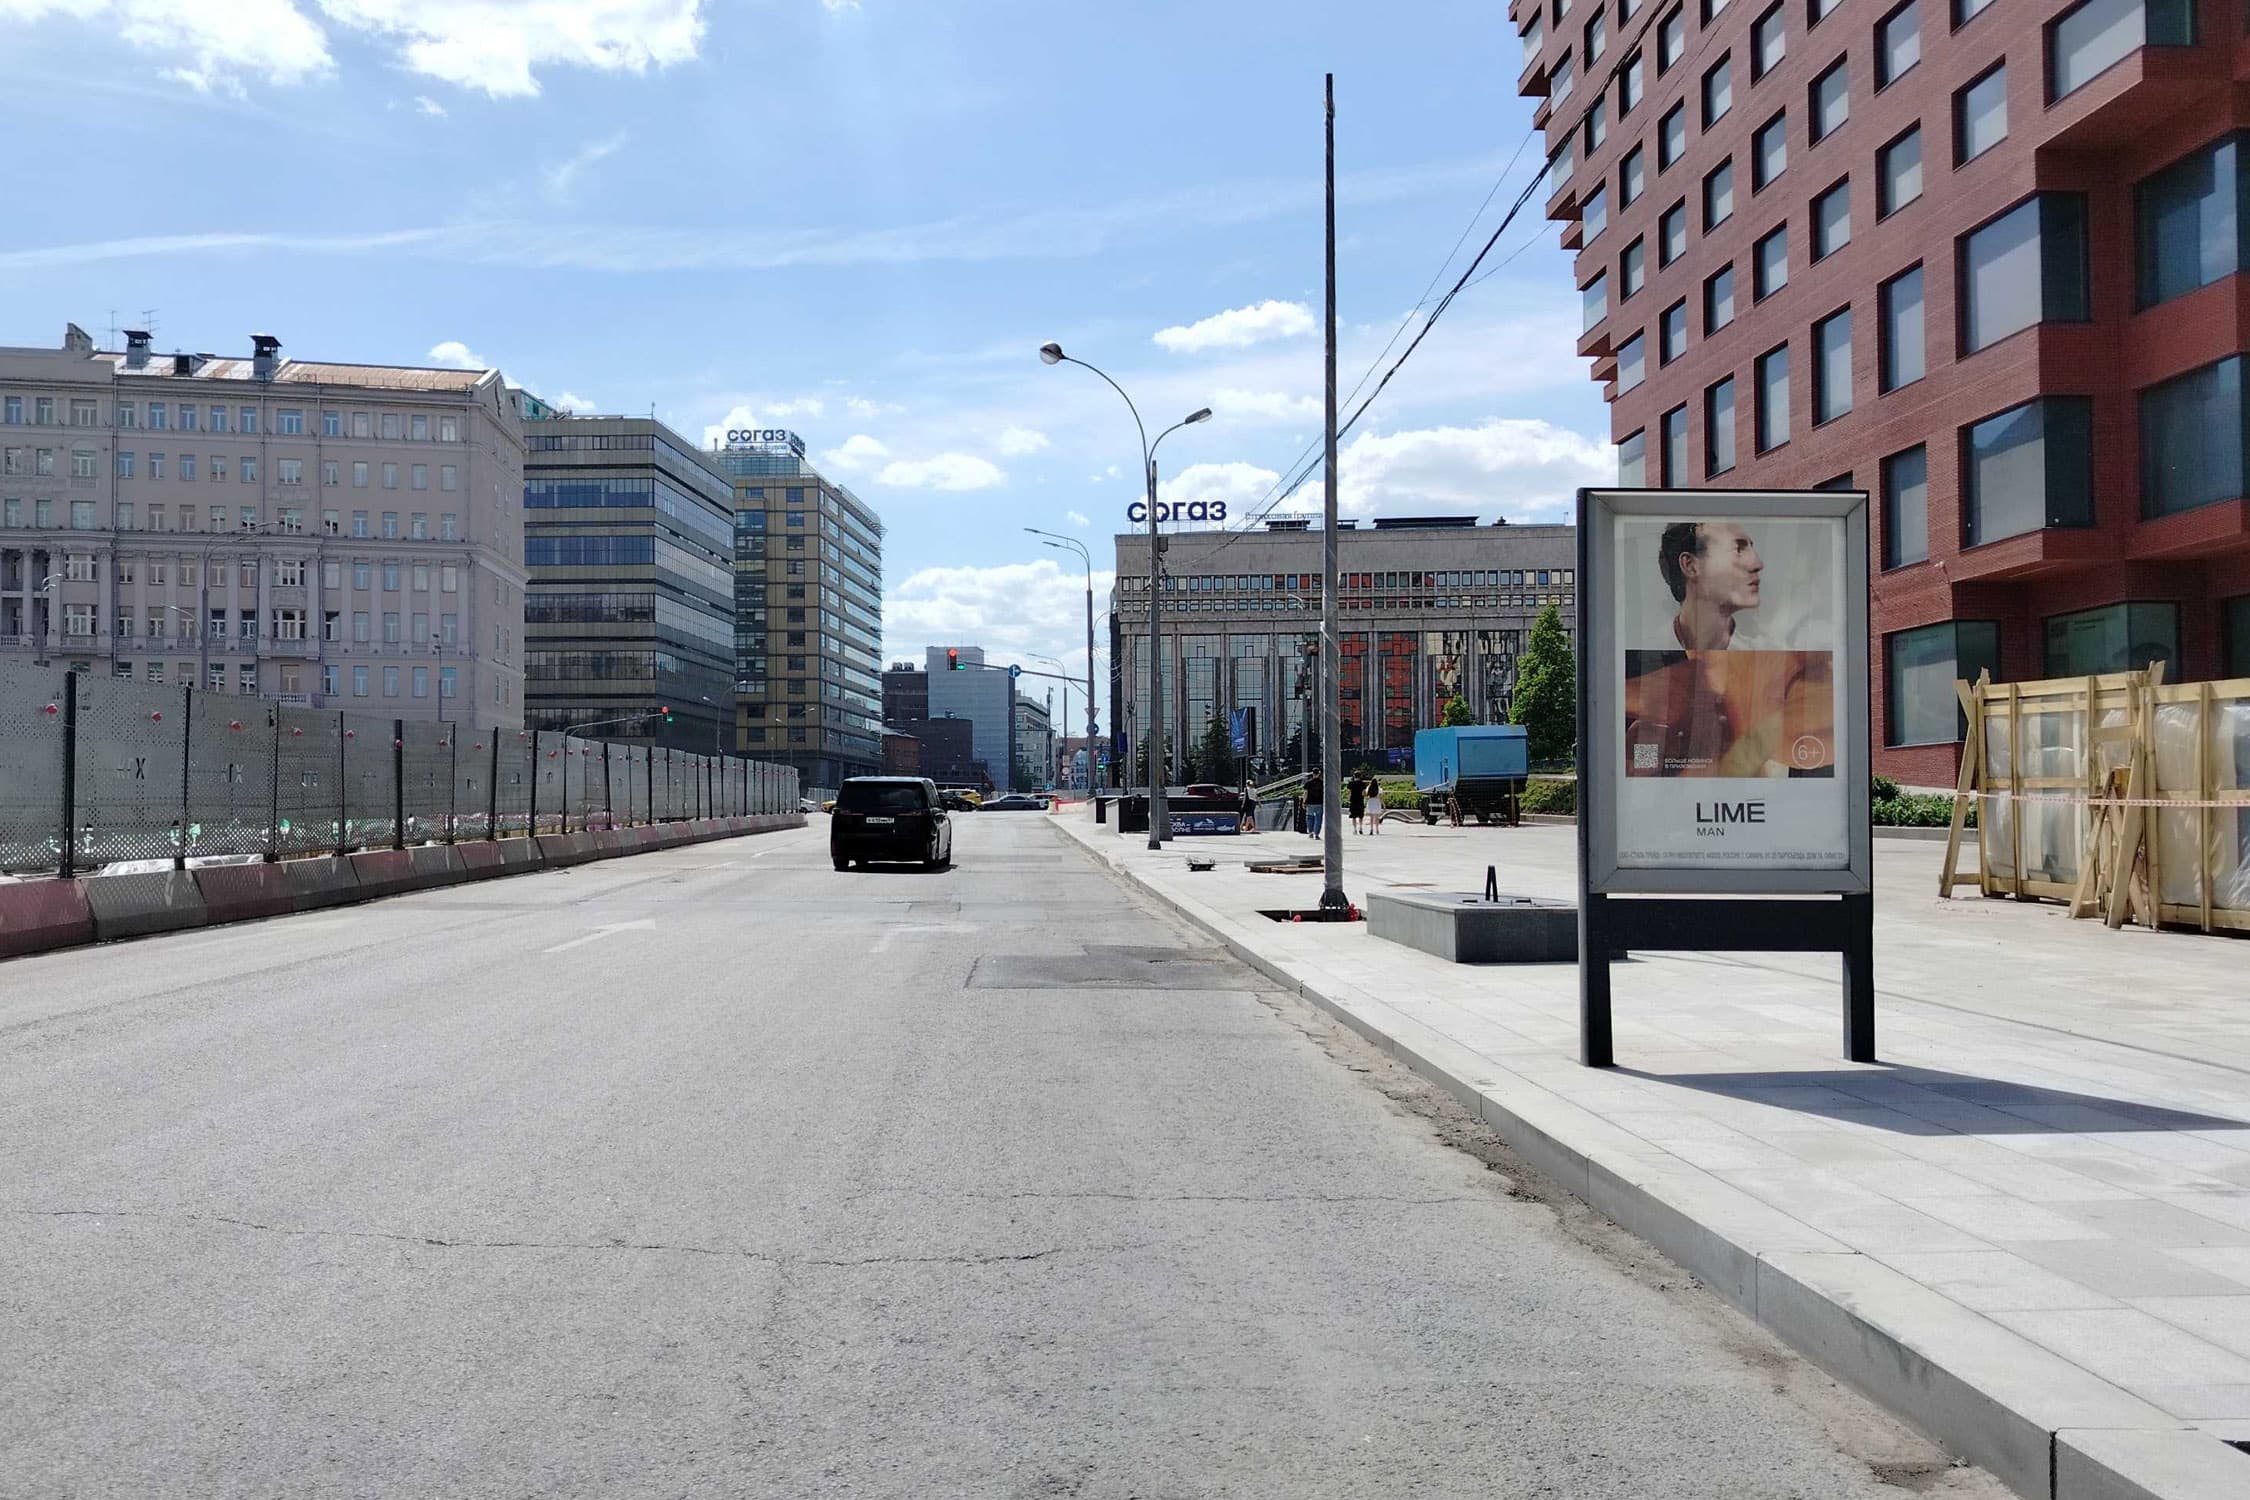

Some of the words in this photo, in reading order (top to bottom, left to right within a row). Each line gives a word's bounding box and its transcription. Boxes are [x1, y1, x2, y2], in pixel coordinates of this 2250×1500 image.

[1798, 744, 1821, 760] 6+
[1696, 802, 1765, 823] LIME
[1697, 827, 1725, 837] MAN
